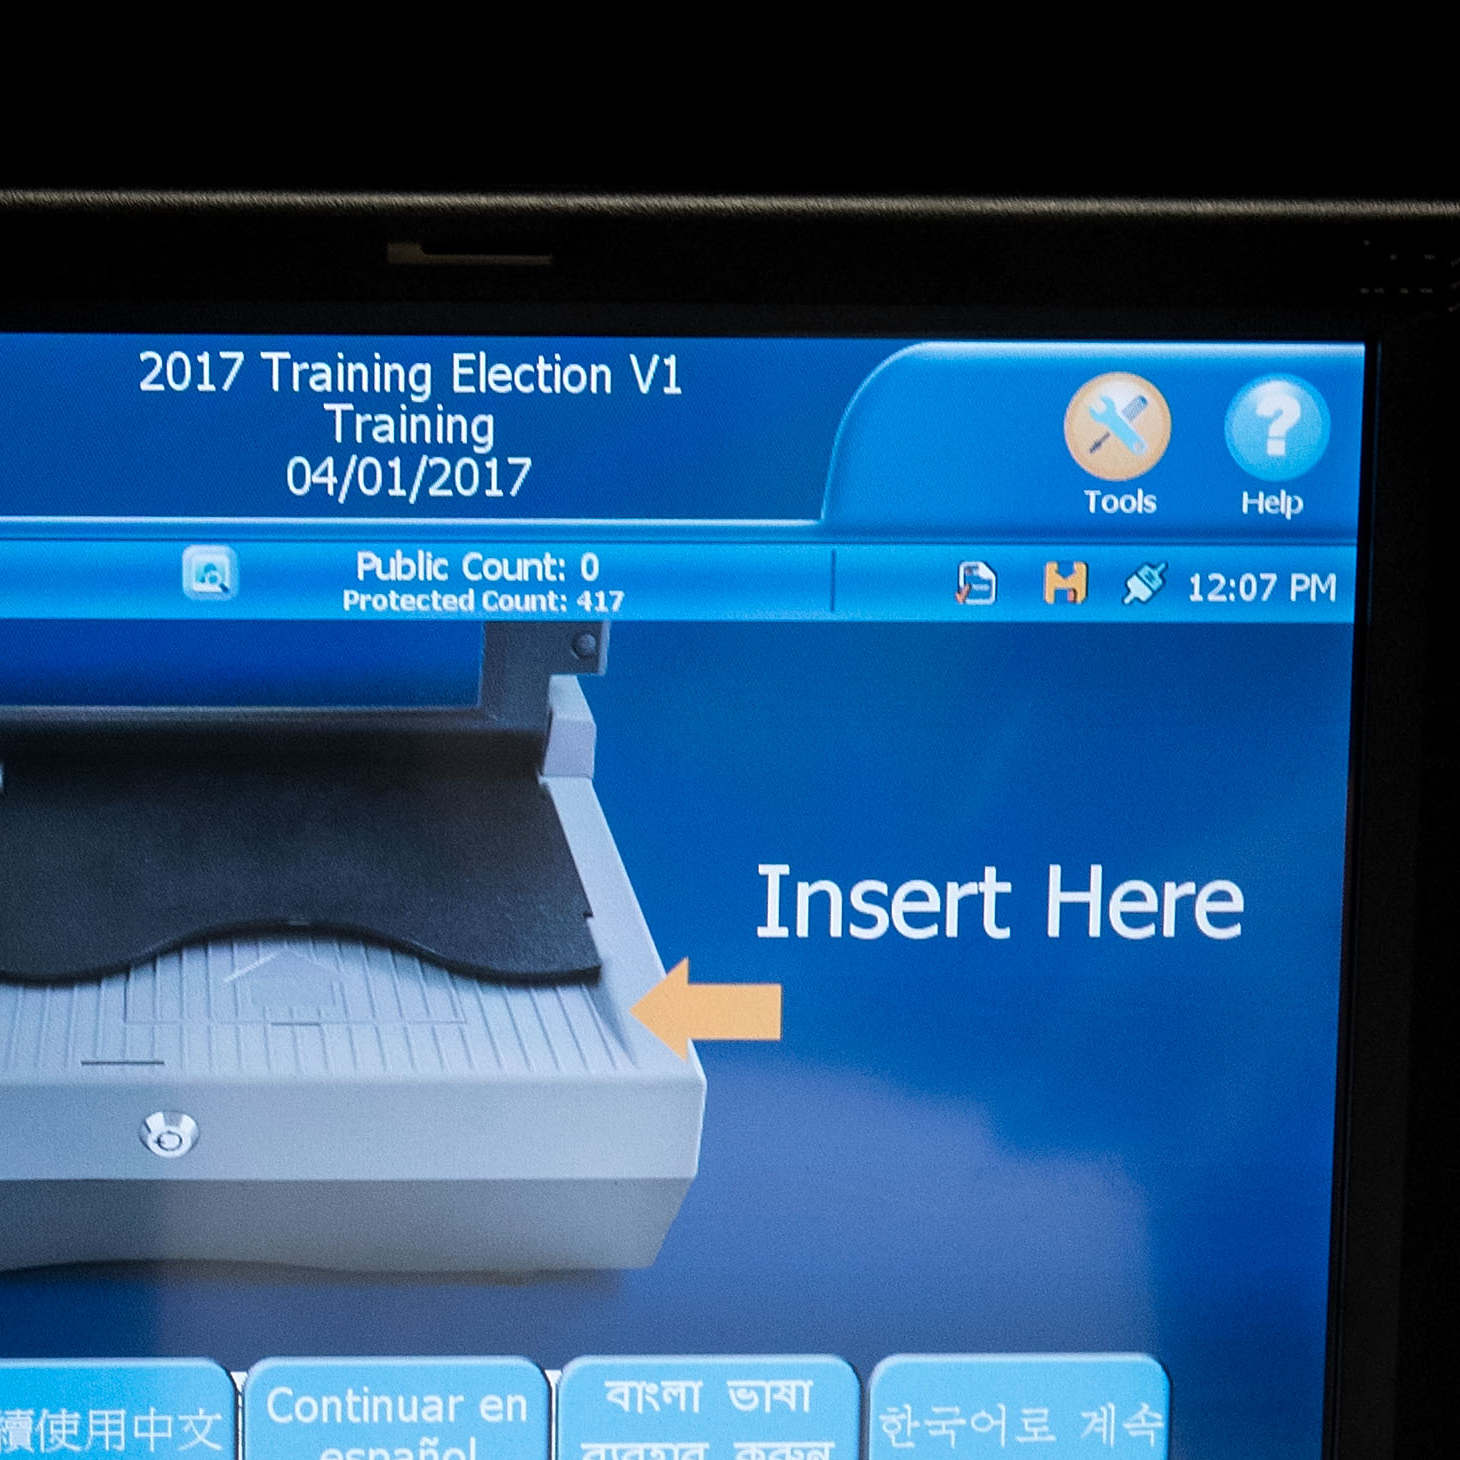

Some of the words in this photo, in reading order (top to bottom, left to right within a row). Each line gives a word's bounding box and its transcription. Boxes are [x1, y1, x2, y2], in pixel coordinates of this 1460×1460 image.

[140, 351, 244, 392] 2017
[261, 352, 432, 402] Training
[452, 353, 612, 394] Election
[629, 354, 682, 395] V1
[324, 403, 494, 452] Training
[286, 455, 532, 504] 04/01/2017
[1084, 489, 1157, 516] Tools
[1242, 490, 1305, 520] Help
[356, 550, 448, 582] Public
[462, 552, 566, 583] Count:
[580, 552, 599, 582] 0
[343, 589, 474, 612] Protected
[481, 590, 568, 613] Count:
[576, 590, 624, 613] 417
[1190, 574, 1281, 603] 12:07
[1290, 572, 1337, 603] PM
[757, 863, 1012, 940] Insert
[1047, 863, 1245, 940] Here
[266, 1385, 465, 1424] Continuar
[479, 1393, 528, 1424] en
[604, 1379, 702, 1414] বাংলা
[727, 1378, 814, 1413] ভাষা
[878, 1402, 1058, 1450] 한국어로
[1080, 1400, 1165, 1449] 계속
